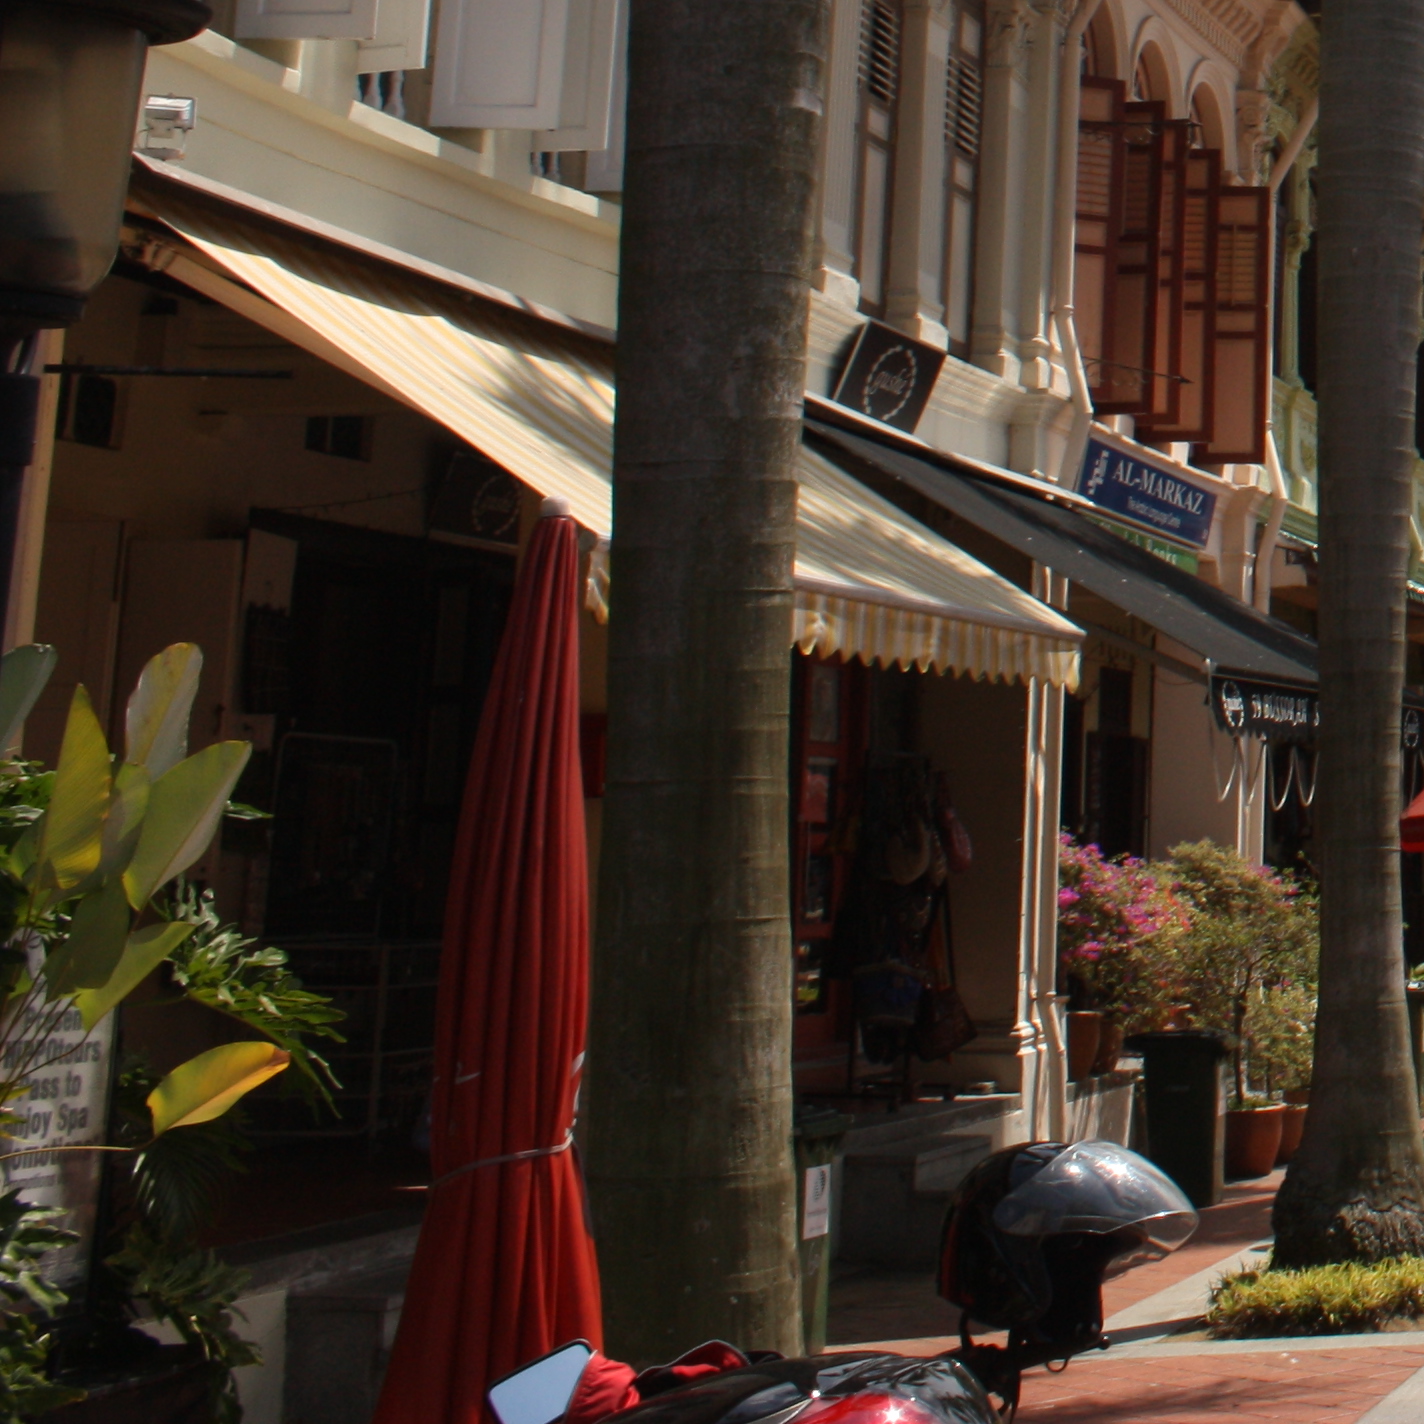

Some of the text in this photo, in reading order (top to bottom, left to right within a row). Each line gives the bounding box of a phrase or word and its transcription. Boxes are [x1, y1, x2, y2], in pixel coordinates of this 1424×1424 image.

[1112, 459, 1204, 515] AL-MARKAZ
[24, 1005, 83, 1033] Presen
[66, 1070, 82, 1097] to
[57, 1103, 88, 1136] Spa
